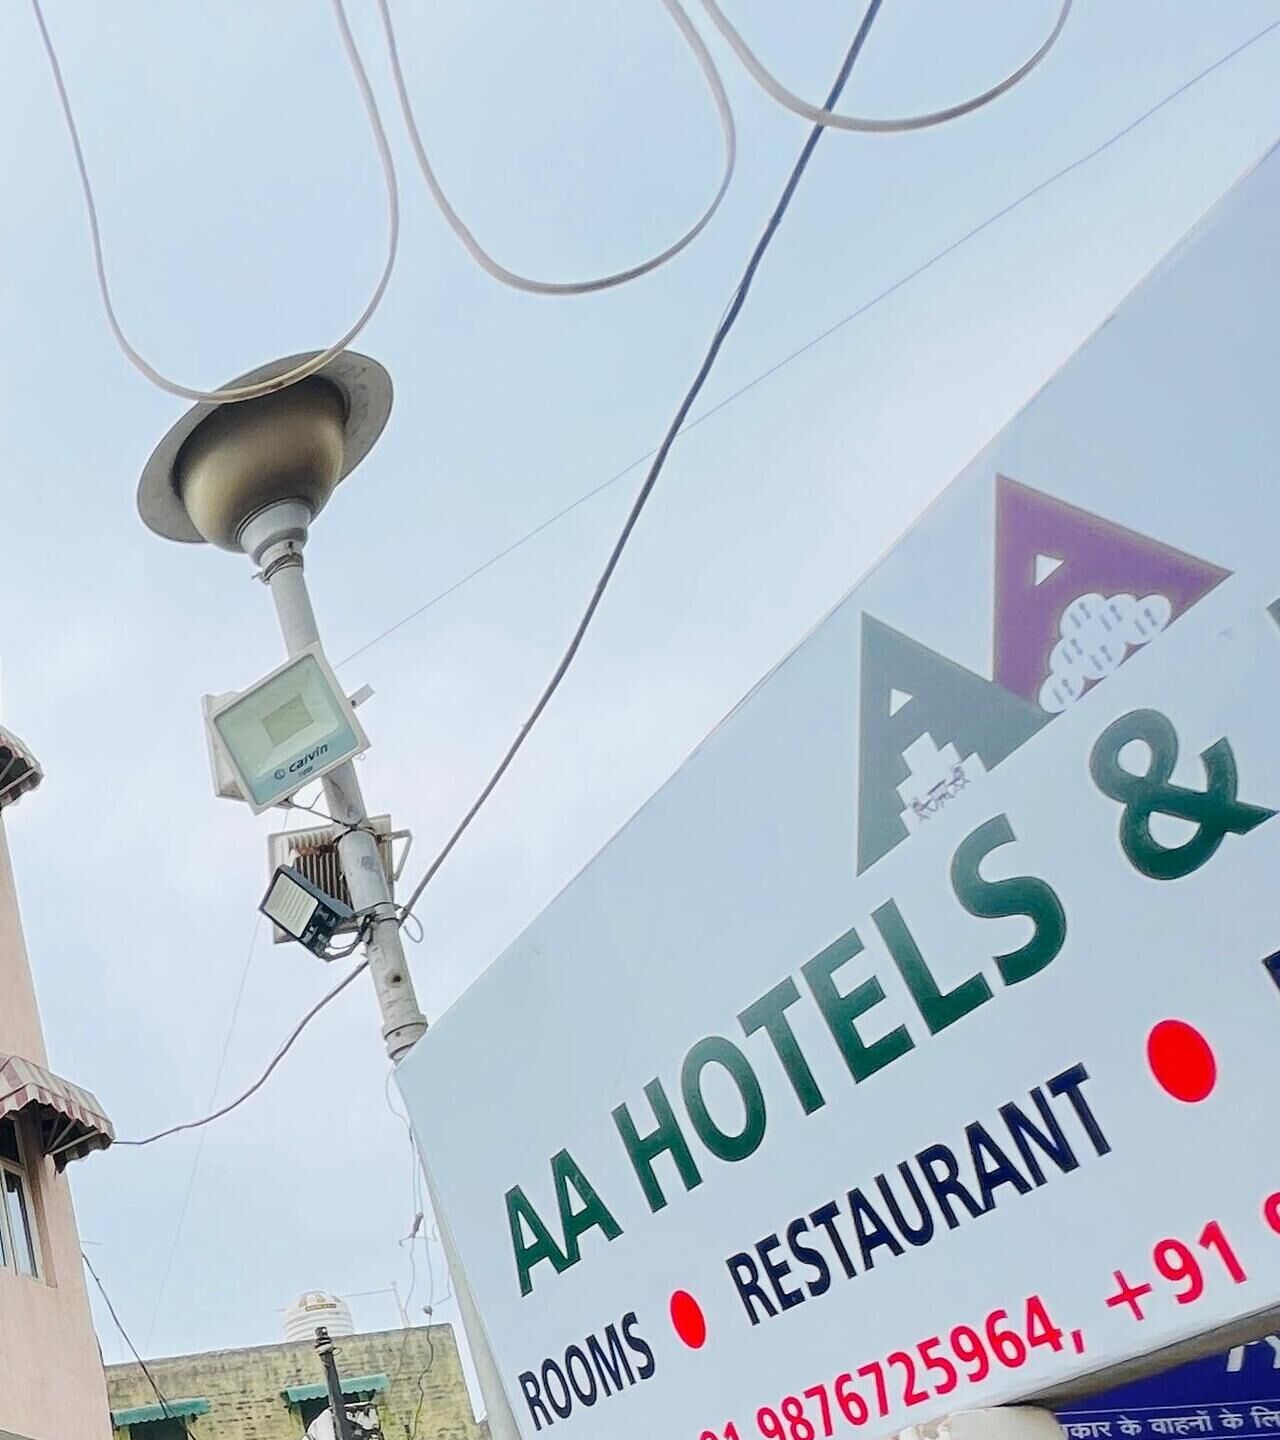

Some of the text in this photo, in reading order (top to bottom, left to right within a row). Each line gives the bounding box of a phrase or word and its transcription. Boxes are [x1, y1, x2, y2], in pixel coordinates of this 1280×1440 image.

[505, 708, 1279, 1297] AA HOTELS &
[518, 1062, 1112, 1432] ROOMS RESTAURANT
[1105, 1219, 1248, 1321] +91
[1117, 1415, 1143, 1436] के
[1148, 1410, 1214, 1436] वाहनों
[1219, 1408, 1244, 1430] के
